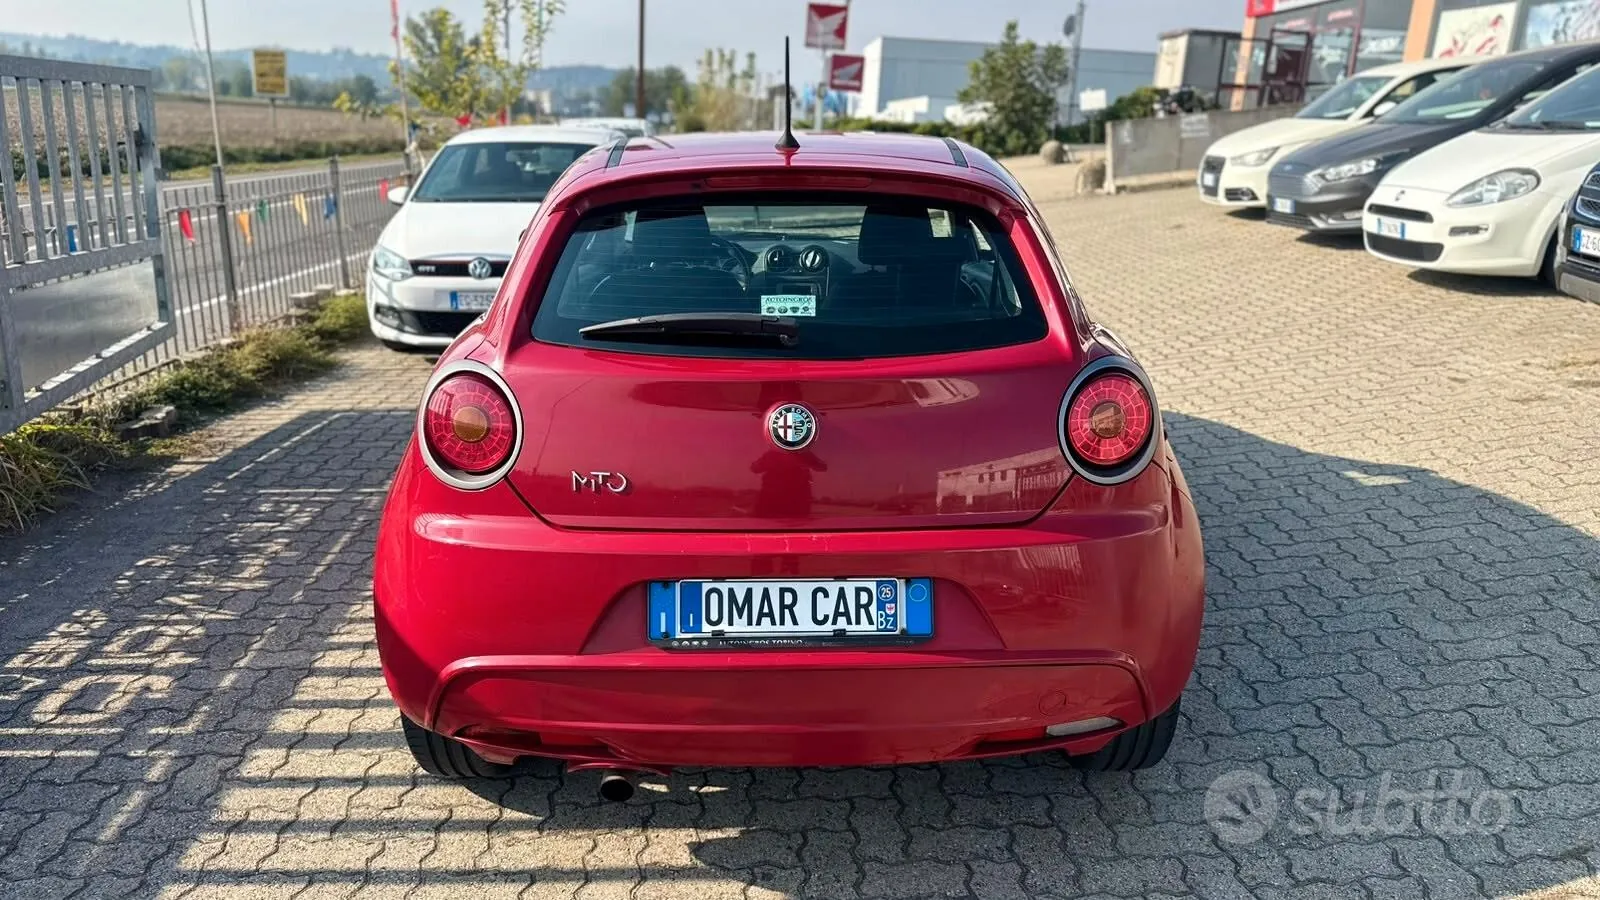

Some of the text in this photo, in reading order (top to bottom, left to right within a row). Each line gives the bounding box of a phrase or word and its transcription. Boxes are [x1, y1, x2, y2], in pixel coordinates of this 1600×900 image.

[881, 587, 892, 598] 25
[704, 585, 875, 627] OMAR CAR
